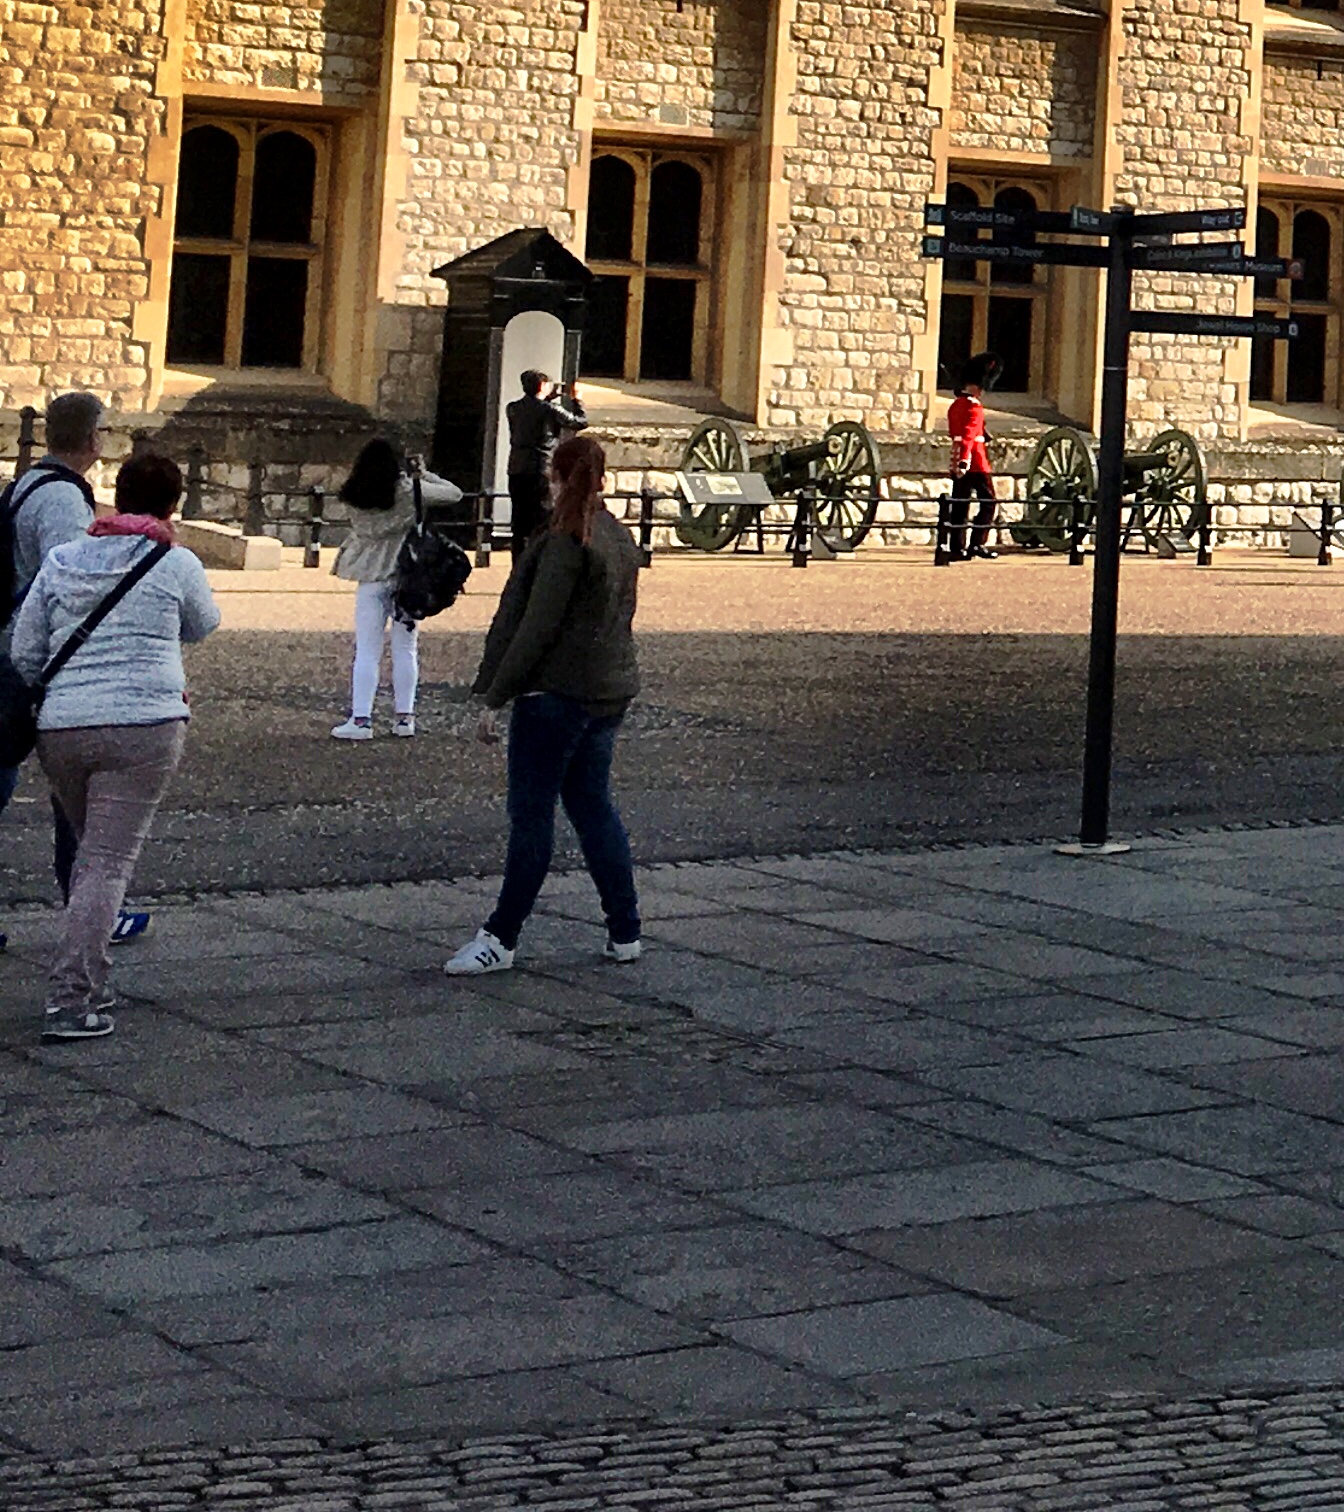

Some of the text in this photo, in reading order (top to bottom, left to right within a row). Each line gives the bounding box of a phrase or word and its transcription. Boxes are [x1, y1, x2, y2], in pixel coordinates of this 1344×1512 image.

[950, 210, 1016, 224] Scaffold Site
[949, 242, 1044, 258] Beauchamp Tower
[1244, 261, 1283, 272] Museum
